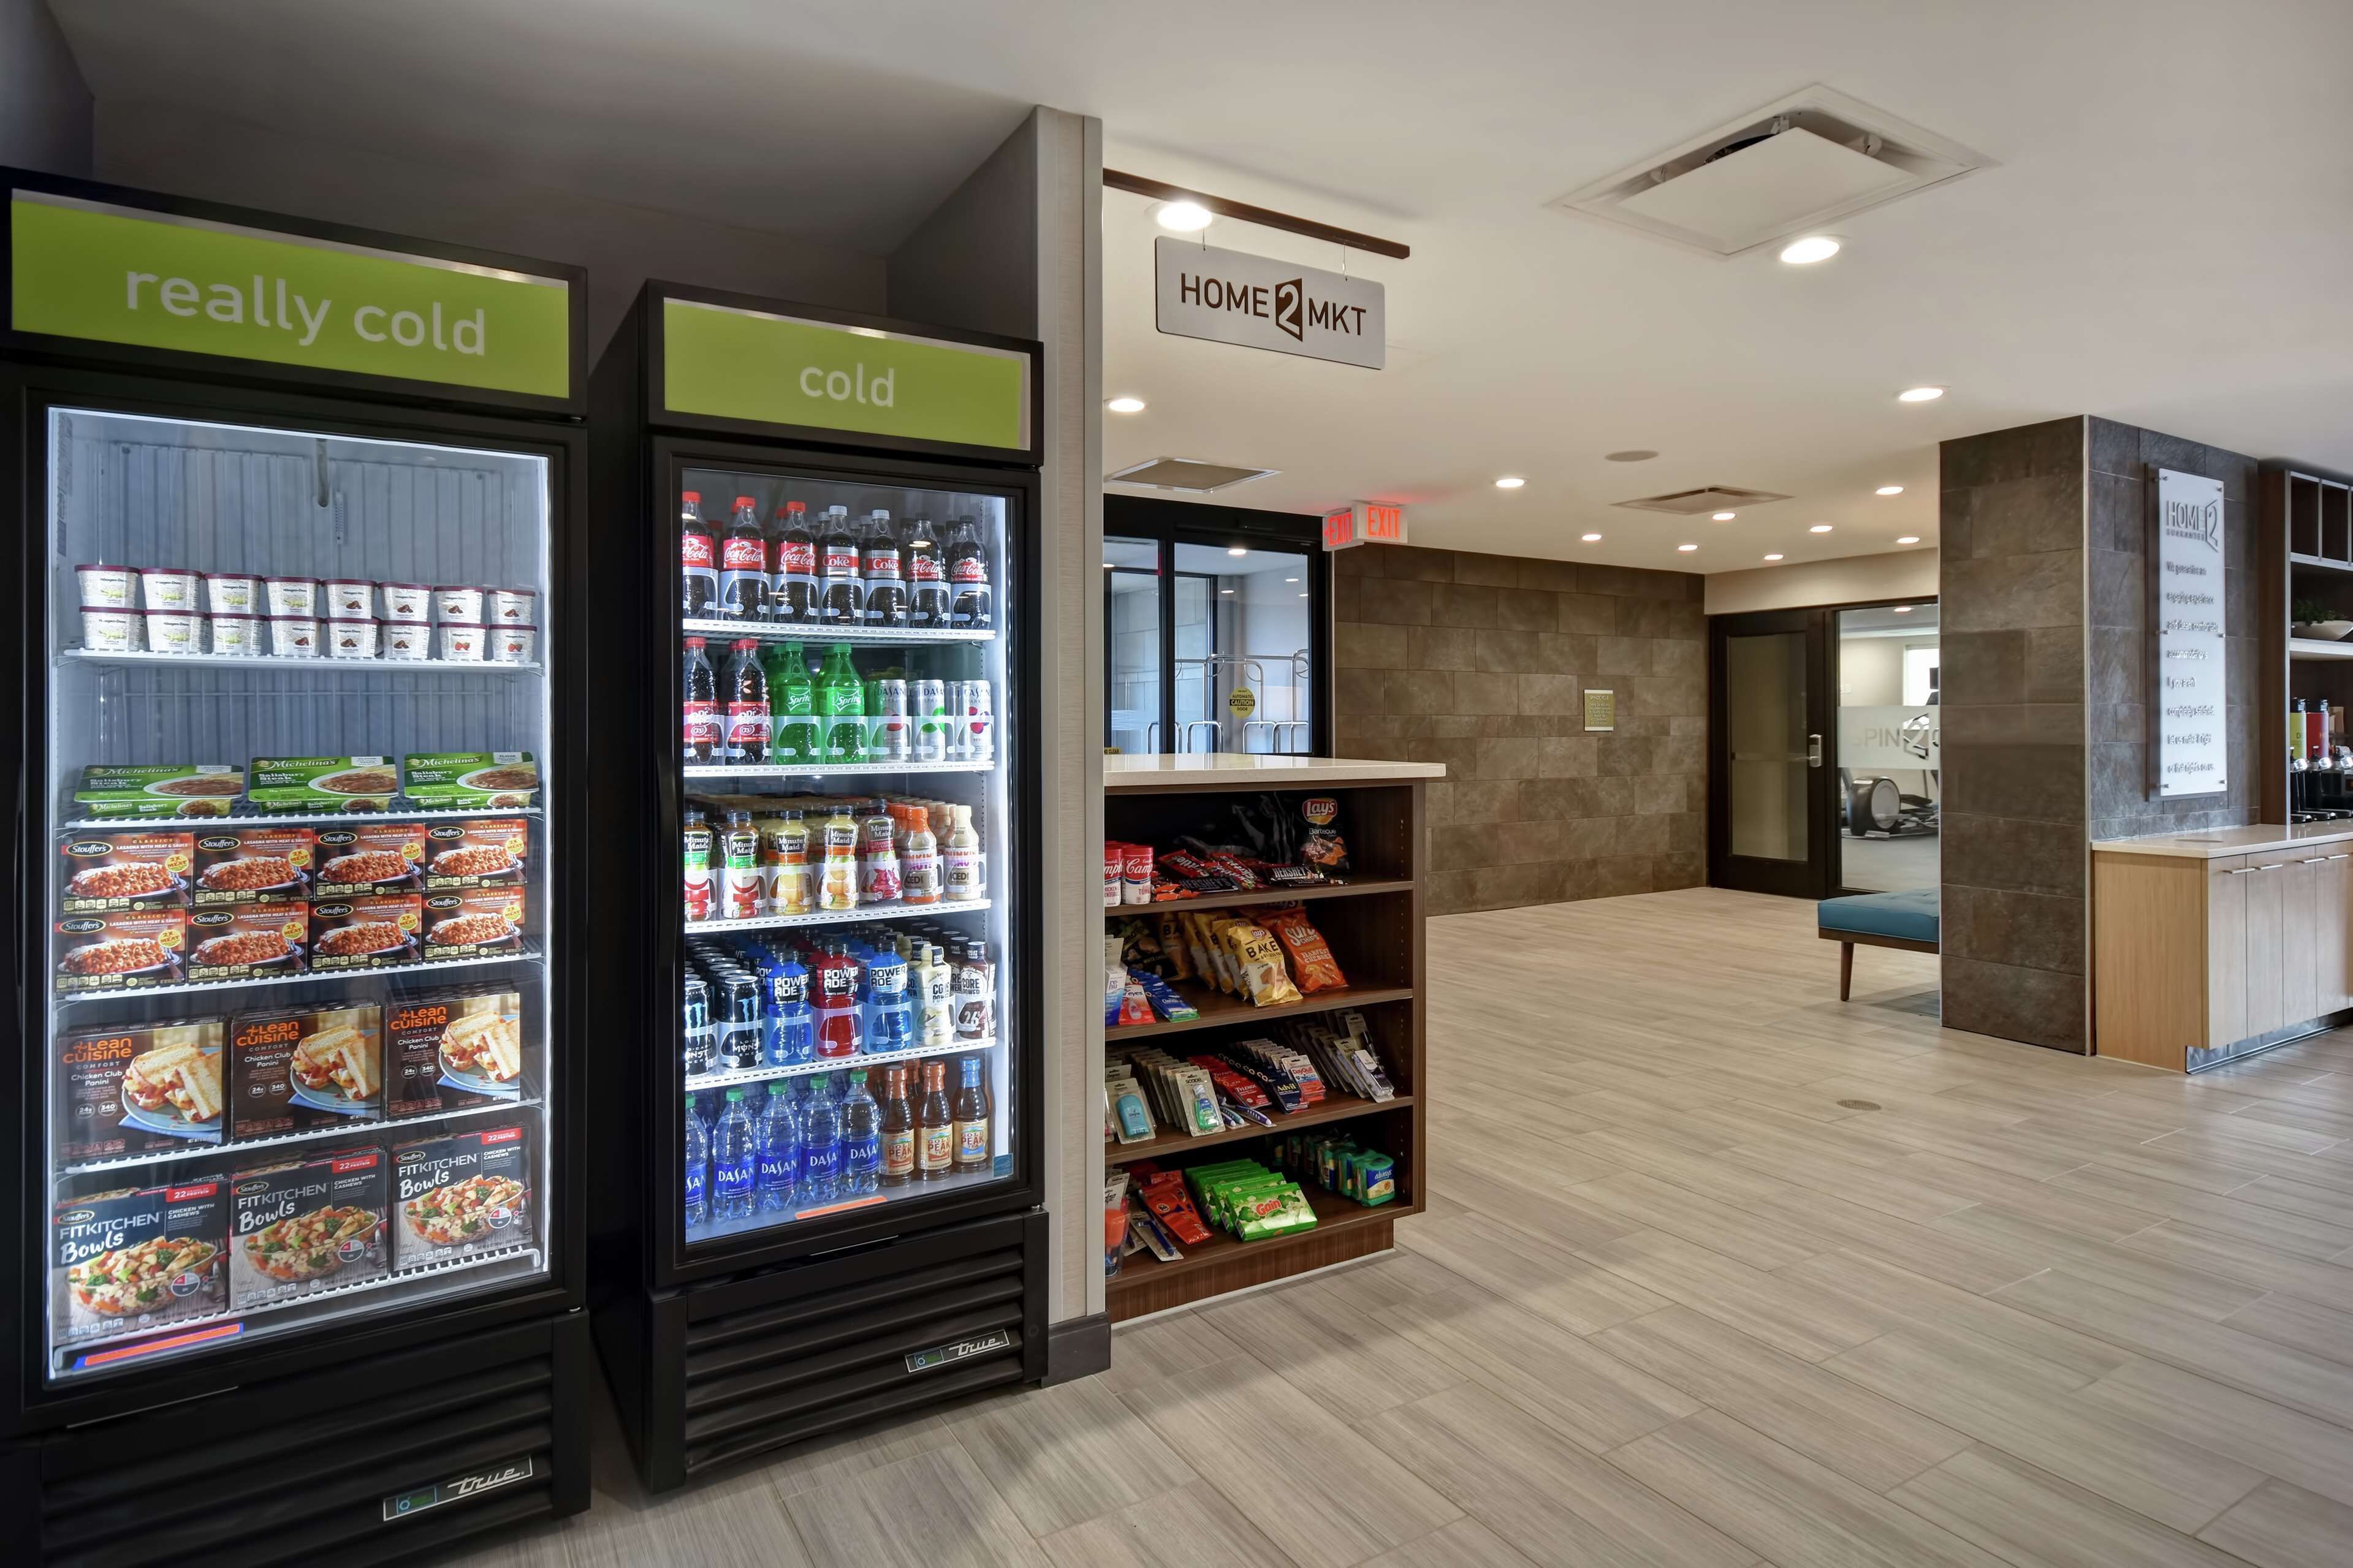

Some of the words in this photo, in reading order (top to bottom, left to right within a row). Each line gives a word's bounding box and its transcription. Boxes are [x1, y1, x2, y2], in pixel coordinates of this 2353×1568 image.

[126, 270, 332, 346] really
[354, 302, 485, 356] cold
[800, 363, 894, 407] cold
[1367, 506, 1401, 539] EXIT
[1328, 512, 1353, 547] EXIT
[724, 543, 764, 562] Coca-Cola
[823, 556, 850, 567] Coke
[873, 558, 899, 570] Coke
[907, 559, 940, 574] Coca-Cola
[788, 695, 811, 705] Sprite
[838, 695, 861, 705] Sprite
[265, 760, 336, 770] Michelina's
[420, 757, 481, 768] Michelina's
[1307, 801, 1335, 817] Lay's
[203, 839, 235, 848] Stouffer's
[323, 834, 352, 843] Stouffer's
[1272, 866, 1312, 878] HERSHEY'S
[319, 906, 348, 915] Stouffer's
[66, 922, 99, 930] Stouffer's
[1245, 941, 1279, 958] BAKE
[824, 967, 858, 979] POWER
[871, 965, 907, 978] POWER
[774, 974, 809, 987] POWER
[824, 979, 848, 988] ADE
[871, 976, 892, 987] ADE
[962, 979, 979, 989] CORE
[774, 987, 798, 997] ADE
[401, 1027, 437, 1036] COMFORT
[71, 1073, 103, 1081] Chicken
[1277, 1083, 1296, 1092] Advil
[961, 1136, 984, 1145] PEAK
[889, 1146, 912, 1157] PEAK
[927, 1142, 950, 1152] PEAK
[810, 1151, 837, 1167] DASA
[761, 1160, 796, 1176] DASAN
[718, 1167, 753, 1183] DASAN
[1375, 1170, 1392, 1179] always
[334, 1177, 360, 1186] CHICKEN
[400, 1169, 449, 1199] Bowls
[1255, 1199, 1282, 1216] Gain
[168, 1211, 200, 1219] CASHEWS
[239, 1200, 295, 1233] Bowls
[61, 1231, 123, 1264] Bowls
